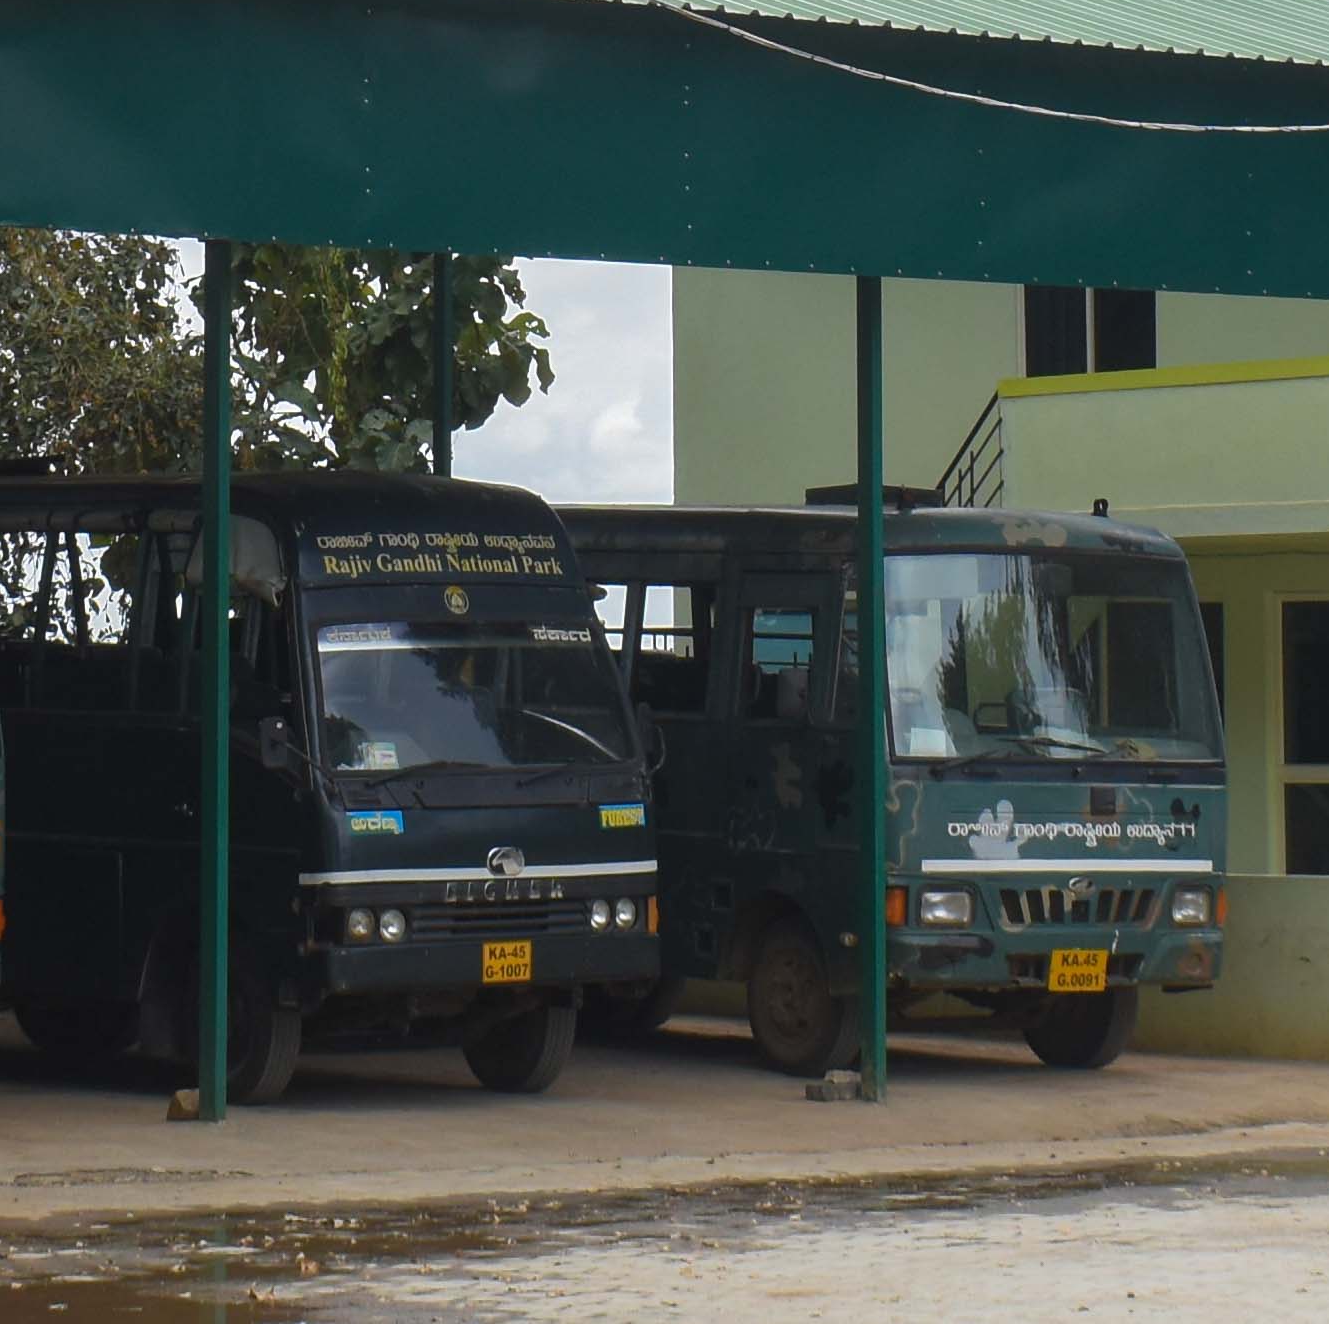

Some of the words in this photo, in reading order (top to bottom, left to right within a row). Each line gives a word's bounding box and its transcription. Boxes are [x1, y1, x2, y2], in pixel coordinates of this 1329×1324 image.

[324, 555, 371, 578] Rajiv
[376, 553, 442, 572] Gandhi
[446, 554, 519, 572] National
[521, 555, 563, 574] Park
[488, 945, 526, 961] KA-45
[485, 963, 528, 979] G-1007
